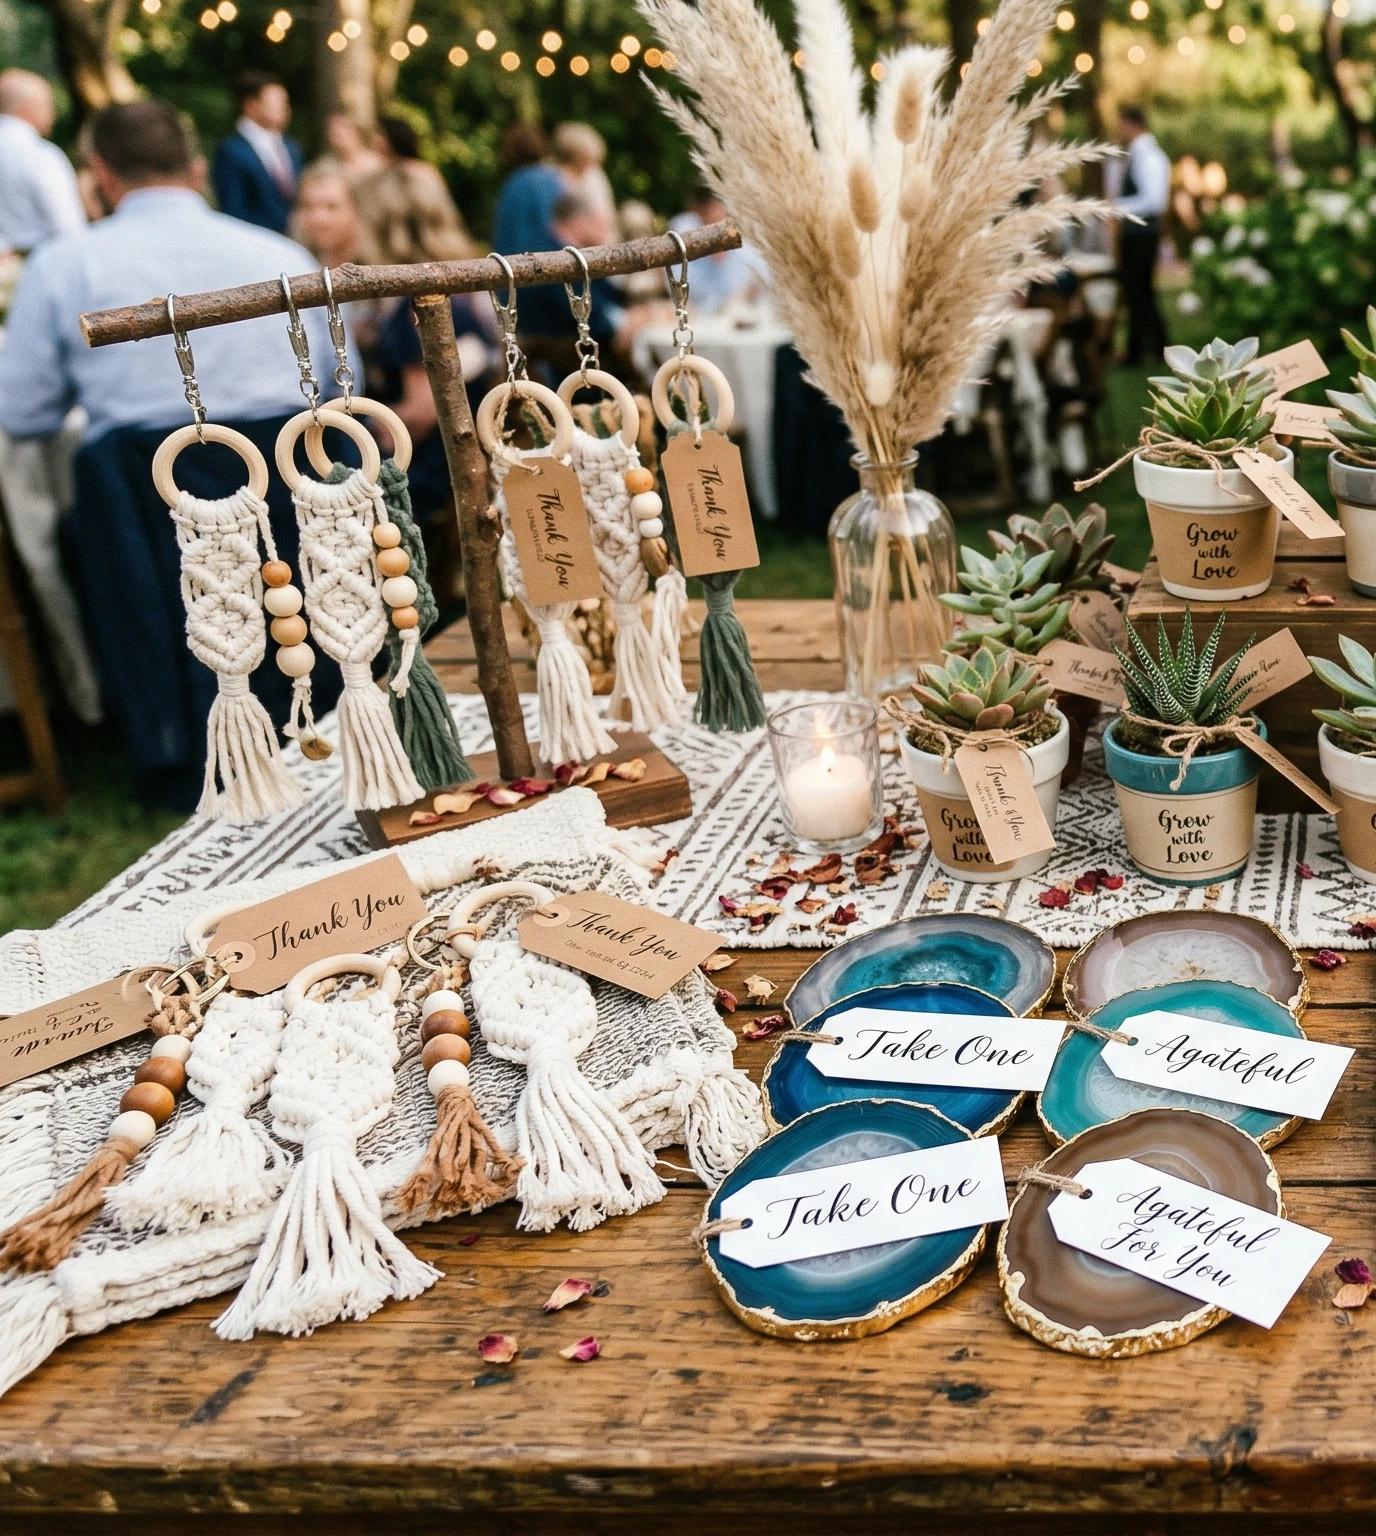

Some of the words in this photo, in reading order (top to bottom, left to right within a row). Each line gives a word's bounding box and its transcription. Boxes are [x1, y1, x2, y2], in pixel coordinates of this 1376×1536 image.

[698, 464, 727, 519] Thank
[537, 488, 569, 545] Thank
[1186, 522, 1241, 543] Grow
[703, 523, 733, 562] You
[1198, 544, 1231, 560] with
[545, 551, 575, 590] You
[1191, 559, 1240, 580] Love
[941, 808, 980, 832] Gro
[1158, 810, 1214, 834] Grow
[1171, 830, 1206, 845] with
[1166, 844, 1213, 864] Love
[253, 902, 349, 960] Thank
[352, 893, 405, 927] You
[567, 908, 643, 945] Thank
[640, 934, 682, 963] You
[848, 1029, 949, 1061] Take
[954, 1034, 1034, 1066] One
[1145, 1034, 1315, 1085] Agateful
[765, 1182, 880, 1240] Take
[891, 1174, 981, 1215] One
[1117, 1186, 1280, 1253] Agateful
[1101, 1222, 1165, 1261] For
[1163, 1245, 1237, 1287] You
